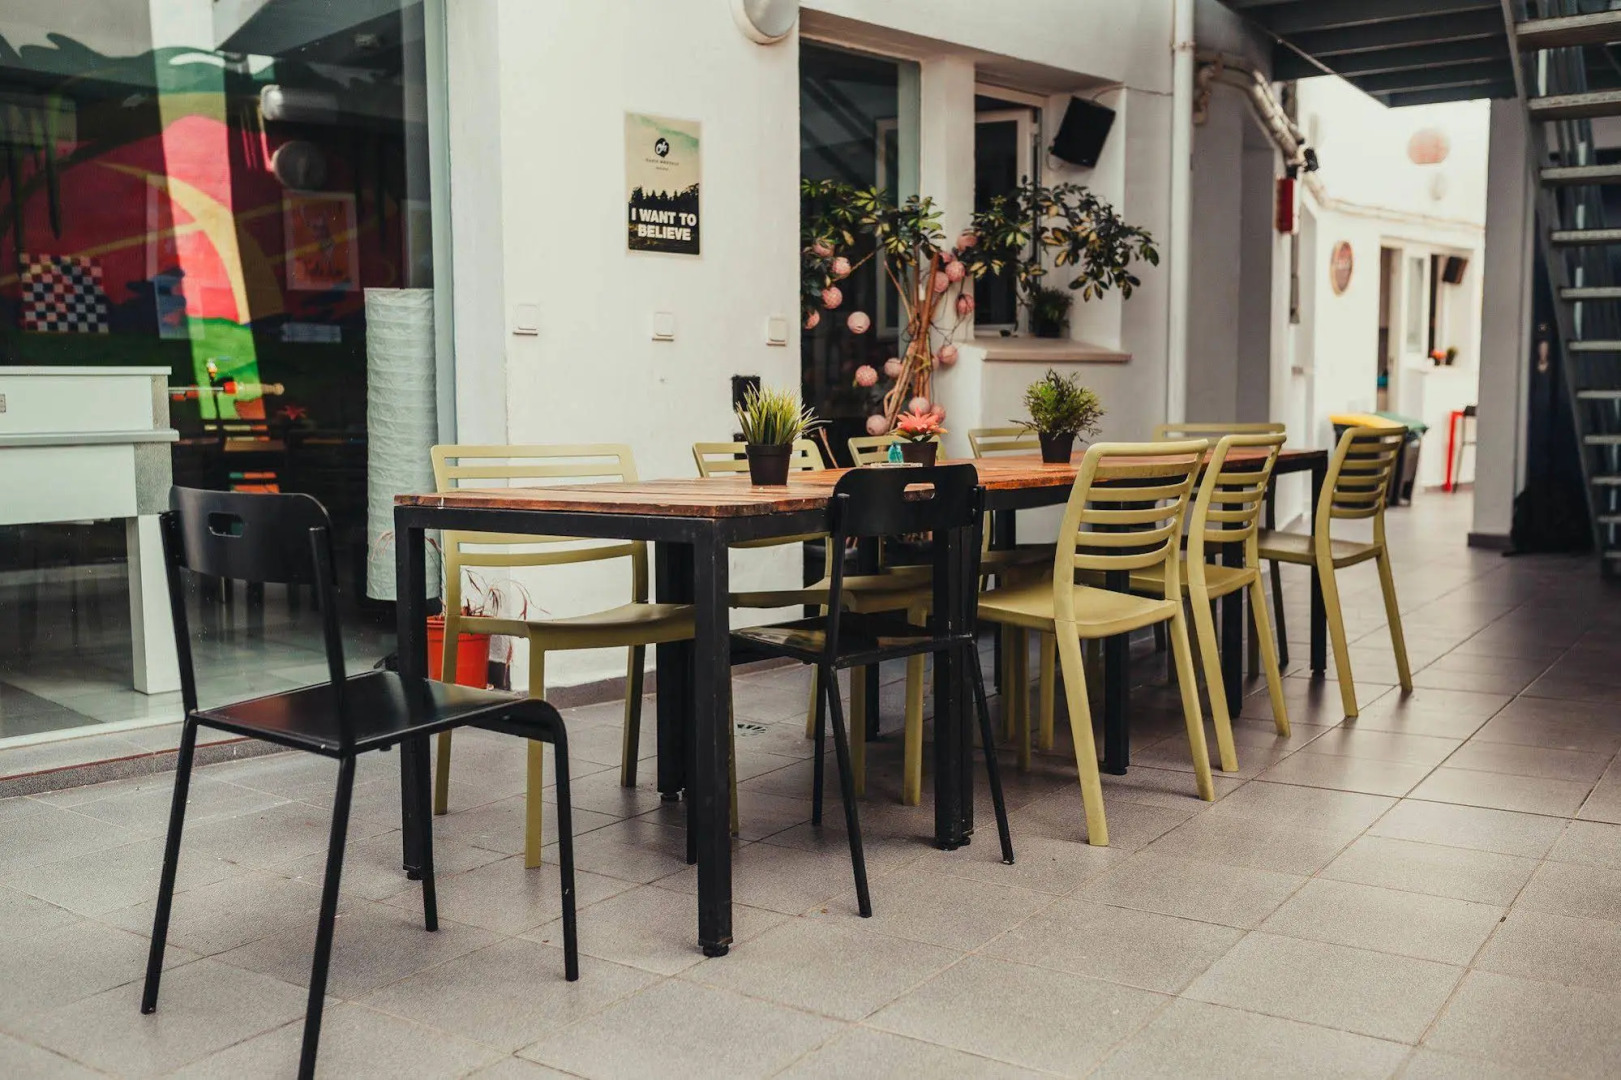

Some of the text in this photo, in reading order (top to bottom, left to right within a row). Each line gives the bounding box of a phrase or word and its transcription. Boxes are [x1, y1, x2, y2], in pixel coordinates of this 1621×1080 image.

[631, 207, 697, 226] I WANT TO
[638, 225, 692, 241] BELIEVE
